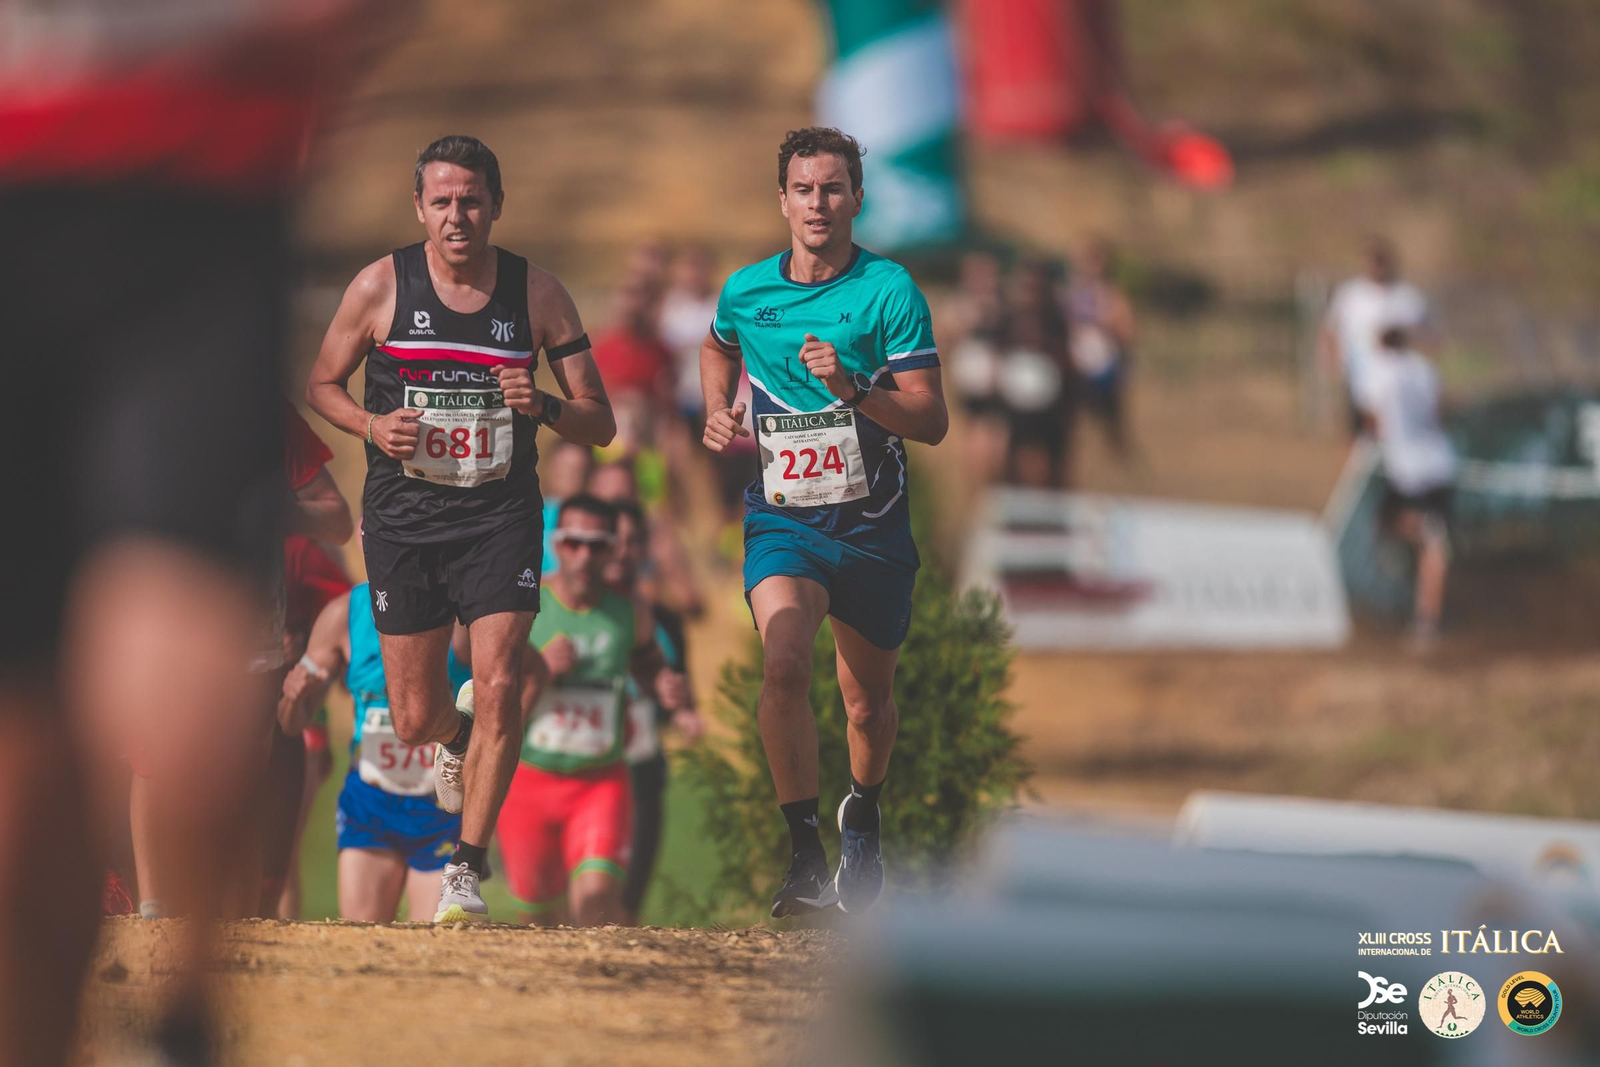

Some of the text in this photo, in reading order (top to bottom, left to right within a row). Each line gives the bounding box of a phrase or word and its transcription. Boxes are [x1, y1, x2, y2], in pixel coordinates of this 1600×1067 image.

[754, 306, 778, 322] 365
[435, 393, 486, 407] ITÁLICA
[781, 415, 827, 430] ITÁLICA
[426, 427, 493, 459] 681
[779, 445, 845, 480] 224
[380, 742, 436, 770] 570
